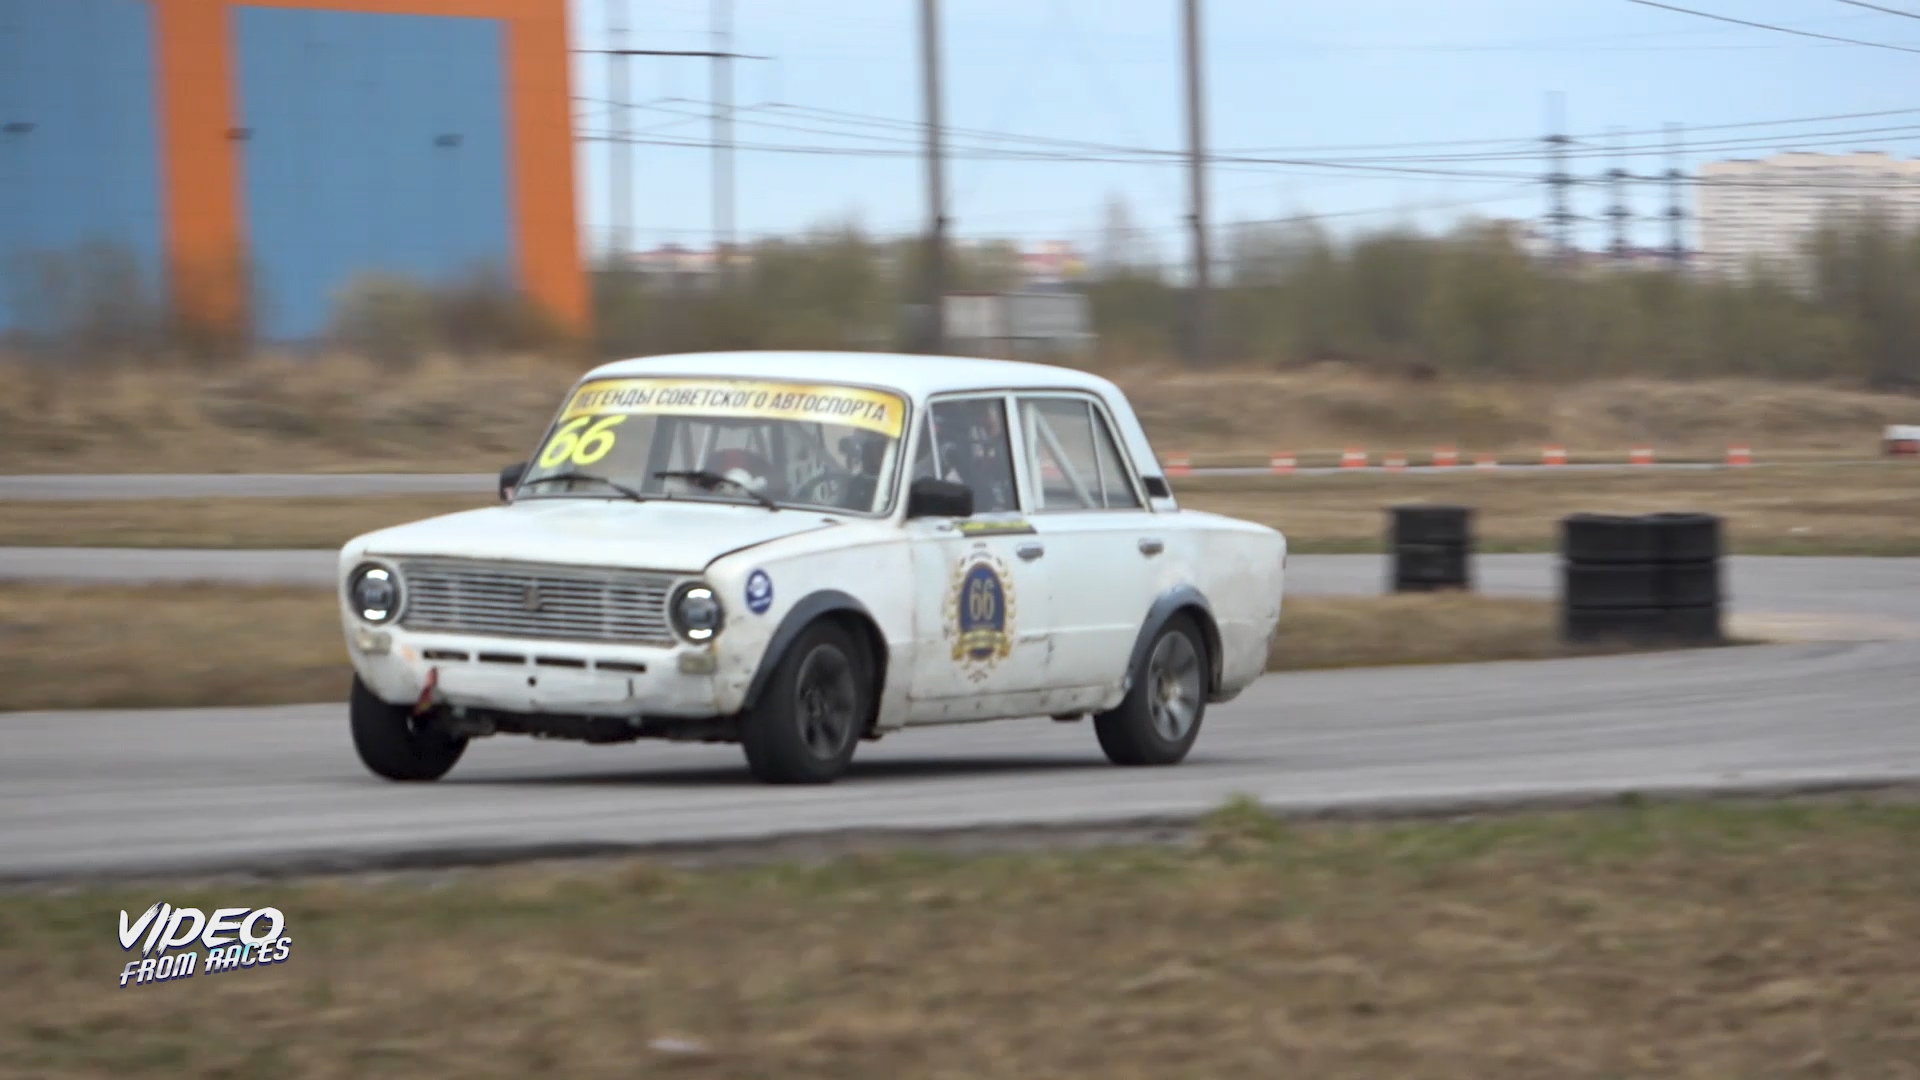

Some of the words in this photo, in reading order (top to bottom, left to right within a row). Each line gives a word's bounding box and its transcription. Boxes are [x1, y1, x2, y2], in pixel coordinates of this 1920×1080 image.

[656, 388, 767, 408] СОВЕТСКОГО
[769, 392, 886, 421] АВТОСПОРТА
[539, 415, 627, 469] 66
[969, 578, 995, 621] 66
